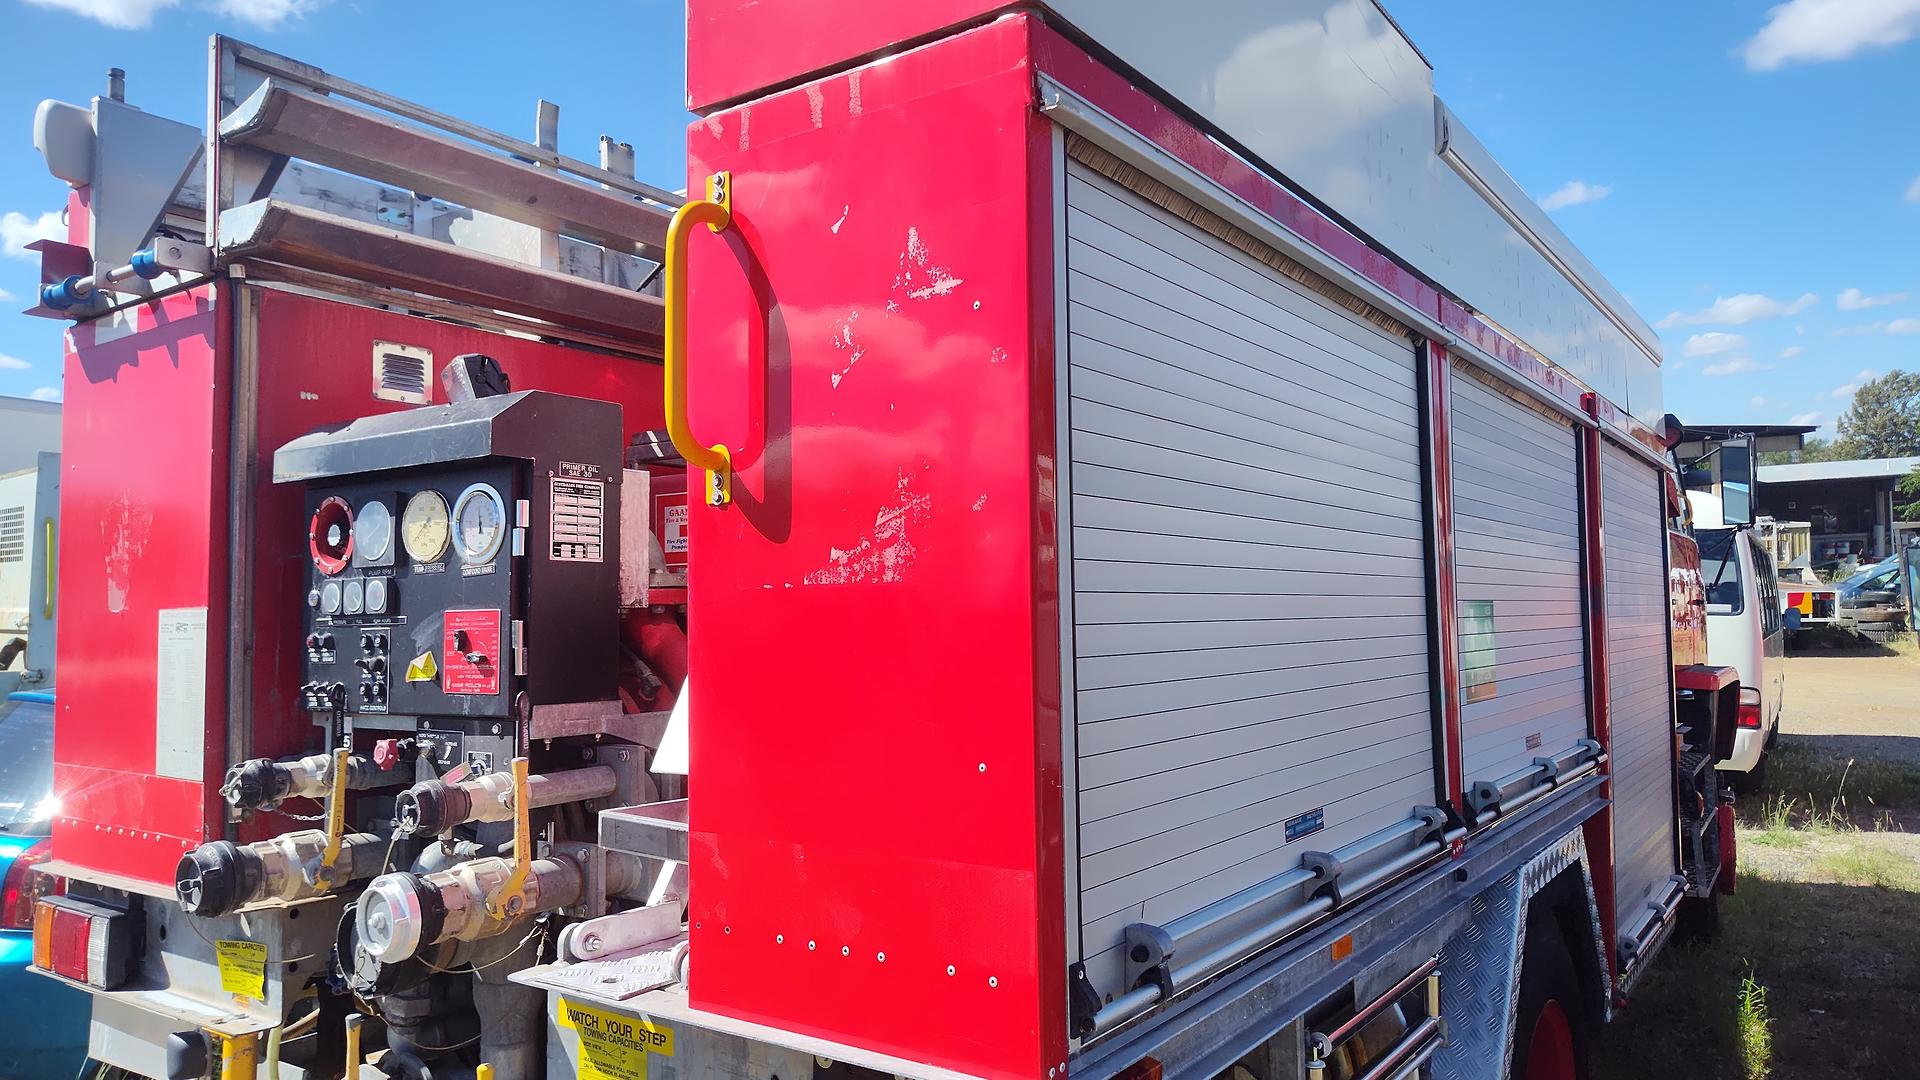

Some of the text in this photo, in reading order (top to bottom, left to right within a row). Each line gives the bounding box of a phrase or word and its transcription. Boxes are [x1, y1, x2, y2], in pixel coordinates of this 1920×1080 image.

[562, 463, 586, 472] PRIMER
[343, 735, 350, 748] 5
[566, 1007, 667, 1047] WATCH YOUR STEP
[583, 1027, 644, 1053] TOWING CAPACITIES
